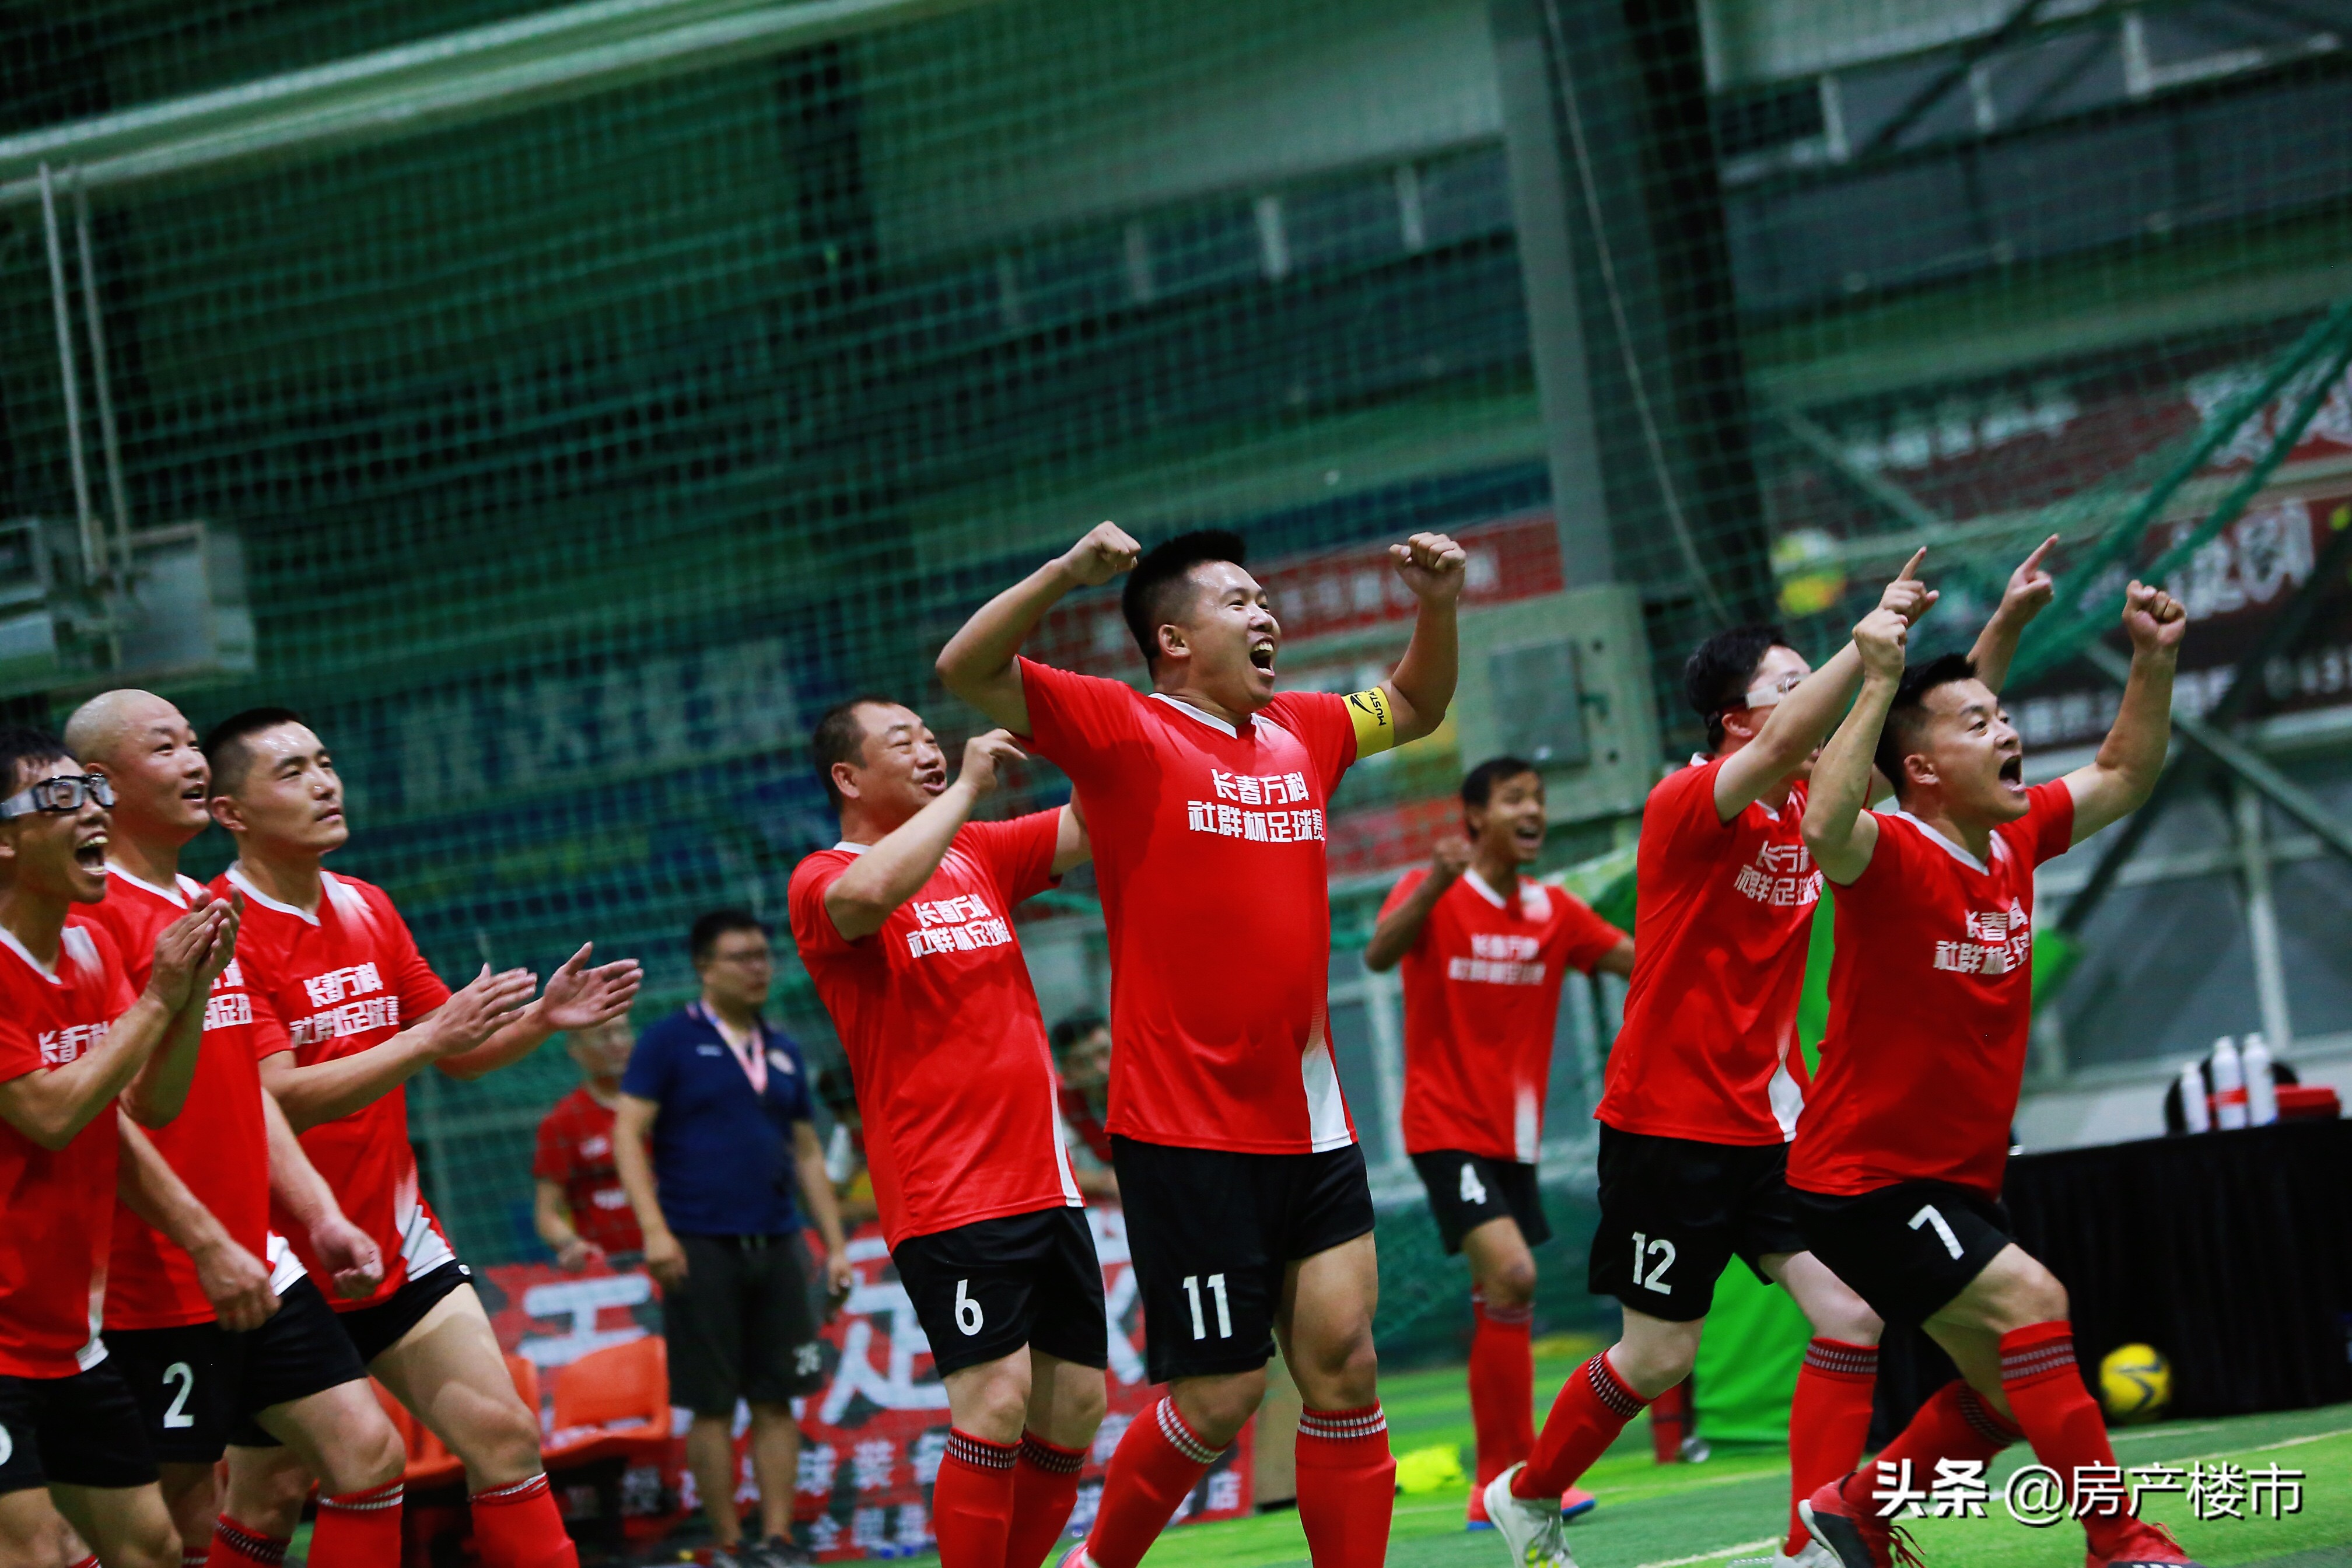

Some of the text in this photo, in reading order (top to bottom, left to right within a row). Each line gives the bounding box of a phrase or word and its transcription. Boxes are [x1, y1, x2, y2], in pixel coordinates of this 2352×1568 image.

[1367, 691, 1387, 727] MUSTA
[1210, 768, 1310, 805] 长春万科
[1187, 800, 1325, 843] 社群杯足球赛
[912, 894, 992, 928] 长春万科
[303, 962, 383, 1007] 长春万科
[1460, 1163, 1487, 1206] 4
[1908, 1204, 1965, 1261] 7
[1632, 1231, 1676, 1295] 12
[955, 1279, 984, 1336] 6
[1183, 1273, 1233, 1340] 11
[162, 1361, 195, 1428] 2
